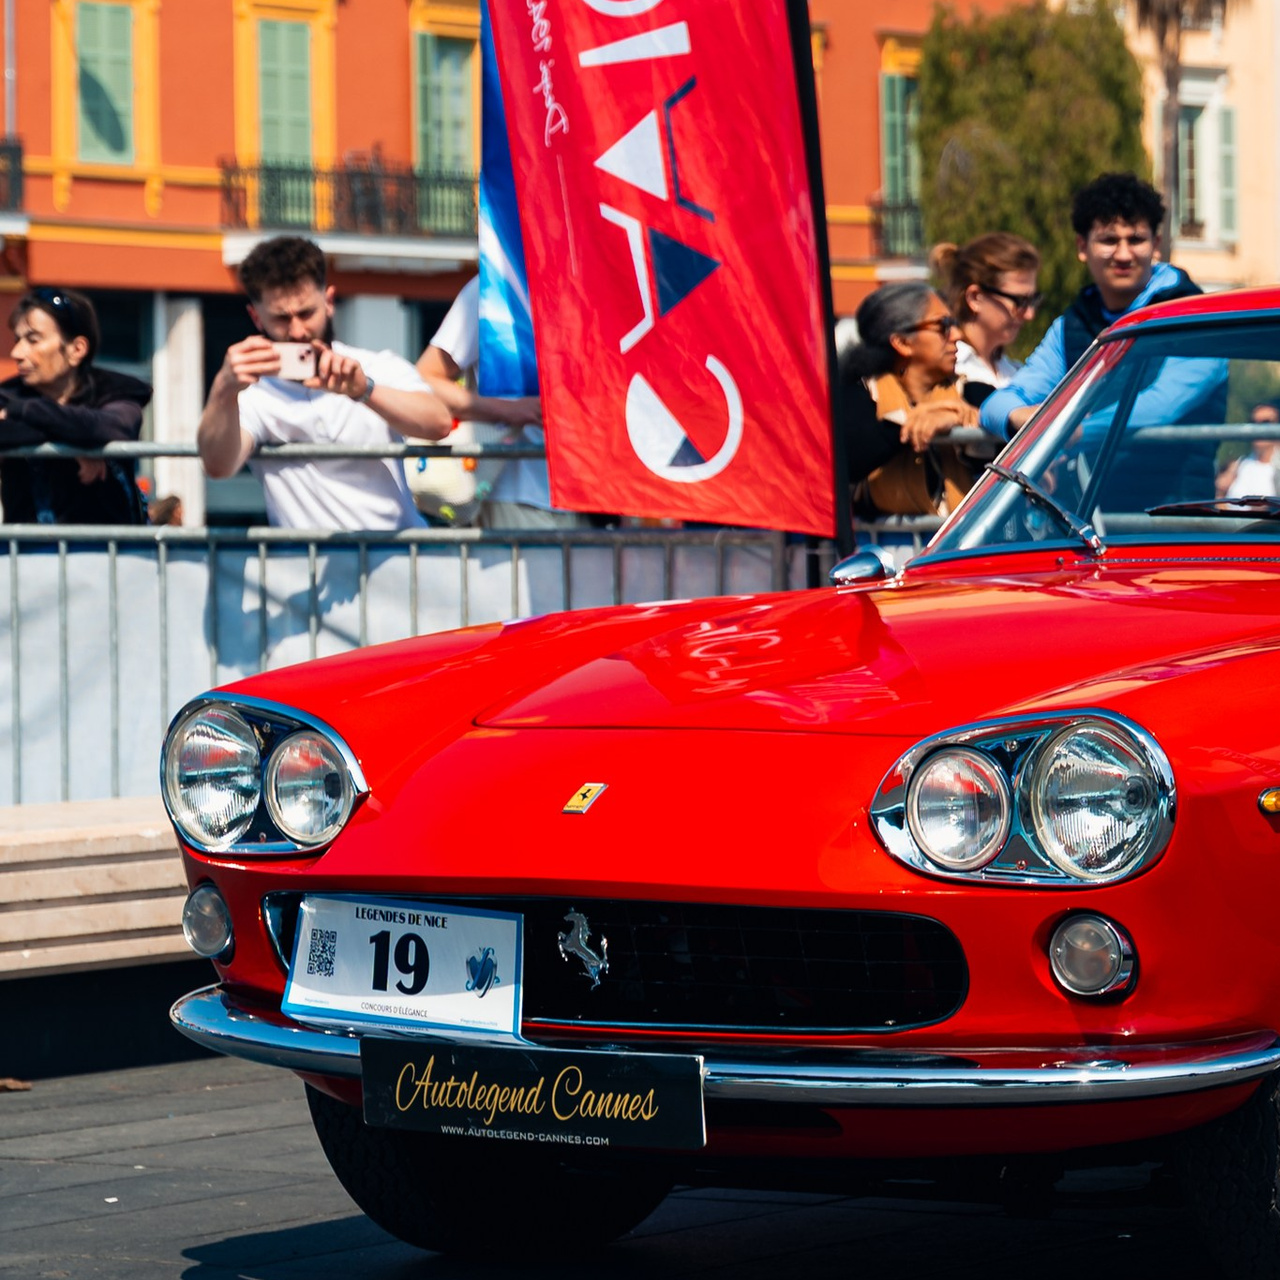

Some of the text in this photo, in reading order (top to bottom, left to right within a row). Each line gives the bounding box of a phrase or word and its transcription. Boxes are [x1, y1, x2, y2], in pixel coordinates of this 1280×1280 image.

[355, 906, 448, 929] LEGENDES DE NICE
[369, 930, 430, 996] 19
[361, 1002, 392, 1013] CONCOURS
[395, 1054, 660, 1126] Autolegend Cannes
[440, 1125, 610, 1146] WWW.AUTOLEGEND-CANNES.COM
